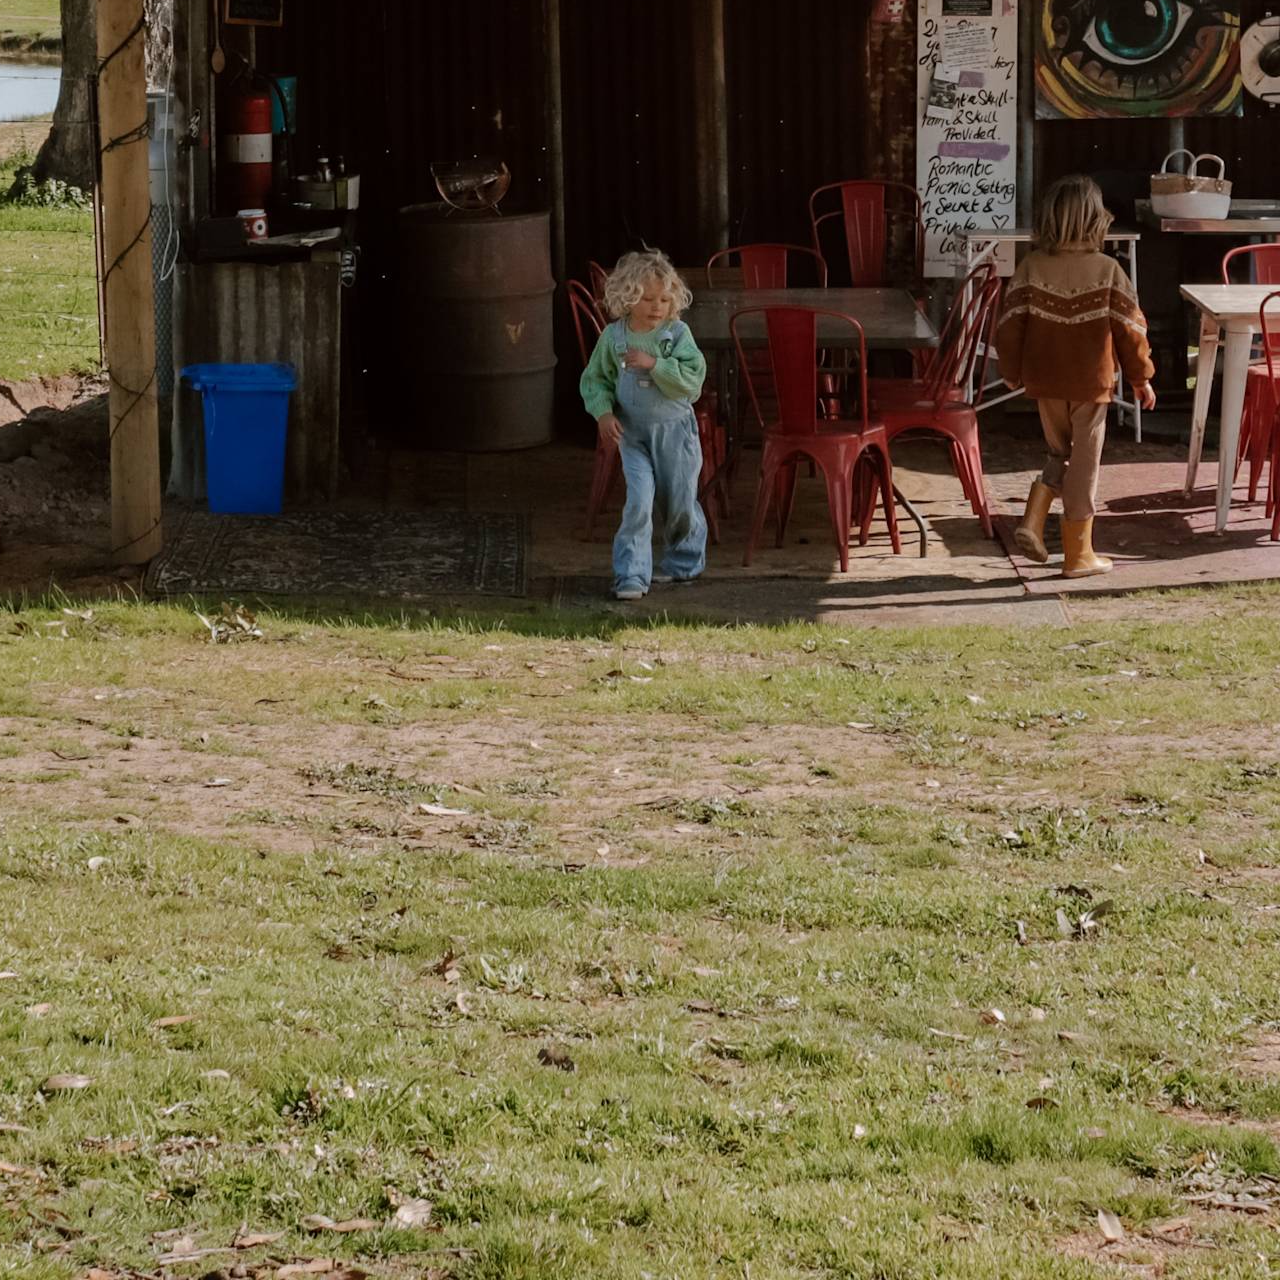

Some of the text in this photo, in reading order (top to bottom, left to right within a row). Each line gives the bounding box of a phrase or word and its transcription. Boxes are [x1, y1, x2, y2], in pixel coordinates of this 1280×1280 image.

[978, 89, 1008, 108] Skull
[965, 110, 998, 125] Skull
[928, 155, 994, 179] Romantic
[925, 177, 1015, 204] Picnic Setting
[936, 197, 980, 216] Secret
